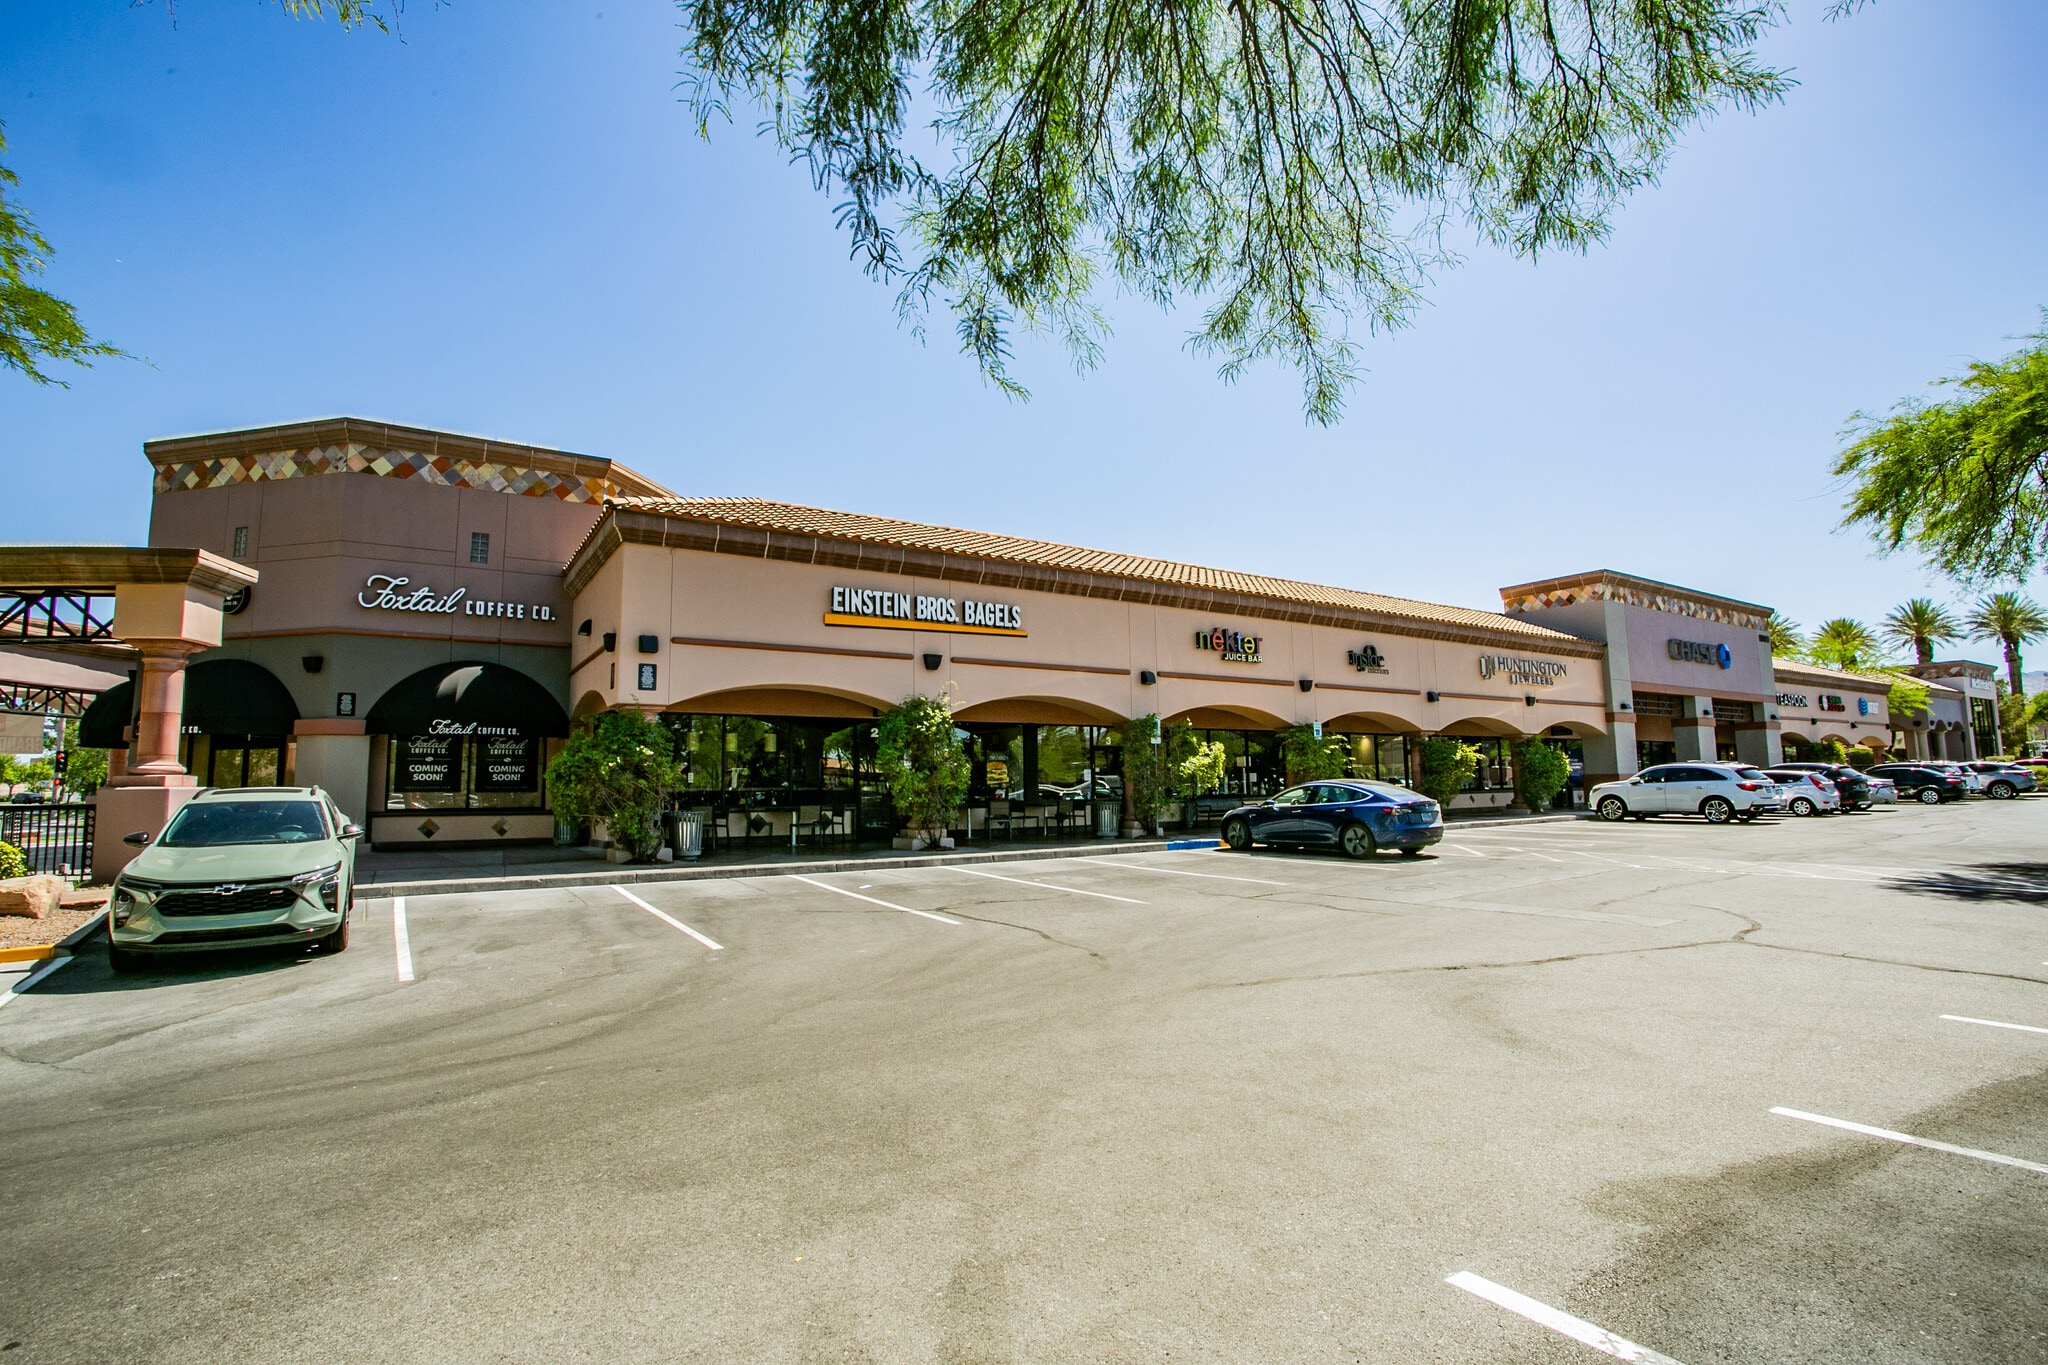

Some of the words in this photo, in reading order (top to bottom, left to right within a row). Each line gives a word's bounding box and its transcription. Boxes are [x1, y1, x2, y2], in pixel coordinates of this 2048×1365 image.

[358, 574, 466, 614] Foxtail
[465, 600, 525, 619] COFFEE
[532, 605, 556, 621] CO.
[832, 586, 911, 619] EINSTEIN
[915, 595, 960, 622] BROS.
[963, 600, 1022, 629] BAGELS
[1224, 653, 1247, 662] JUICE
[1247, 655, 1263, 663] BAR
[1668, 639, 1717, 665] CHASE
[1496, 657, 1567, 677] HUNTINGTON
[1512, 674, 1554, 686] JEWELERS
[1776, 693, 1808, 707] TEASPOON
[429, 719, 477, 735] Foxtail
[477, 727, 505, 735] COFFEE
[870, 727, 879, 738] 2
[408, 735, 452, 749] Foxtail
[487, 737, 529, 750] Foxtail
[1105, 736, 1112, 745] 3
[408, 764, 448, 772] COMING
[488, 765, 525, 773] COMING
[412, 773, 443, 781] SOON!
